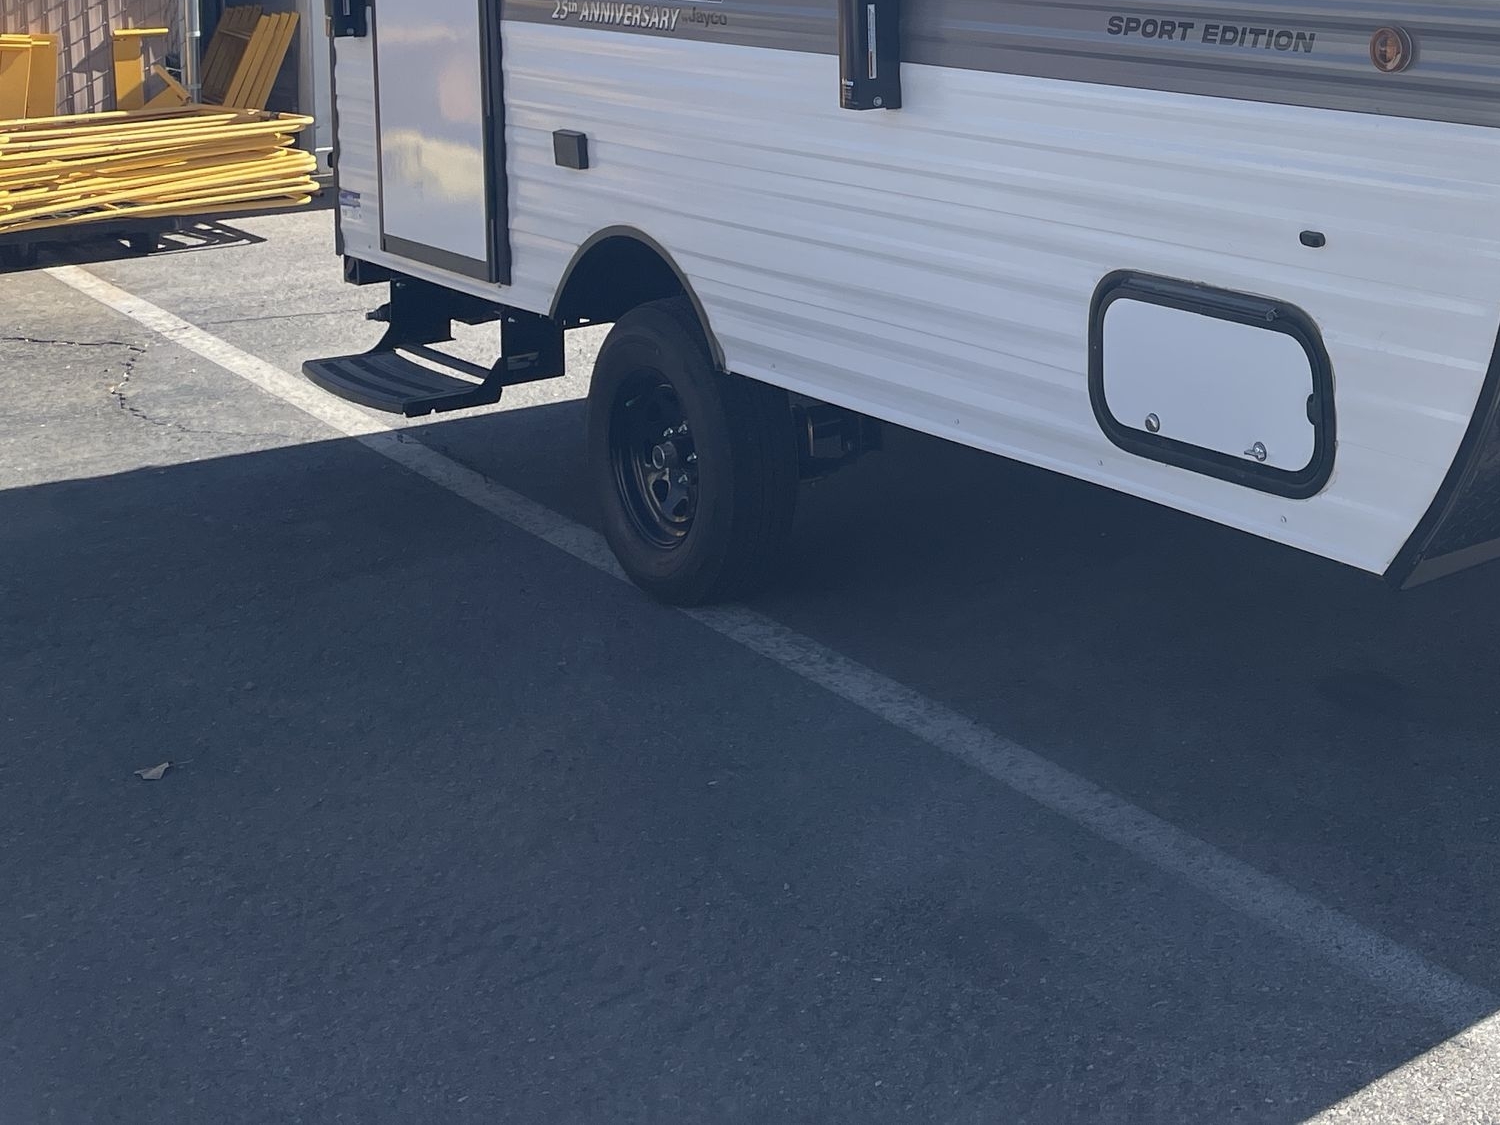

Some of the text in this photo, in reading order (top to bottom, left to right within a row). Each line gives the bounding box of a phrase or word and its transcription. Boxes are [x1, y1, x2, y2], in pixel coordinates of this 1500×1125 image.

[552, 0, 578, 20] 25th
[579, 1, 681, 31] ANNIVERSARY
[689, 7, 728, 27] Jayco
[1107, 16, 1316, 53] SPORT EDITION
